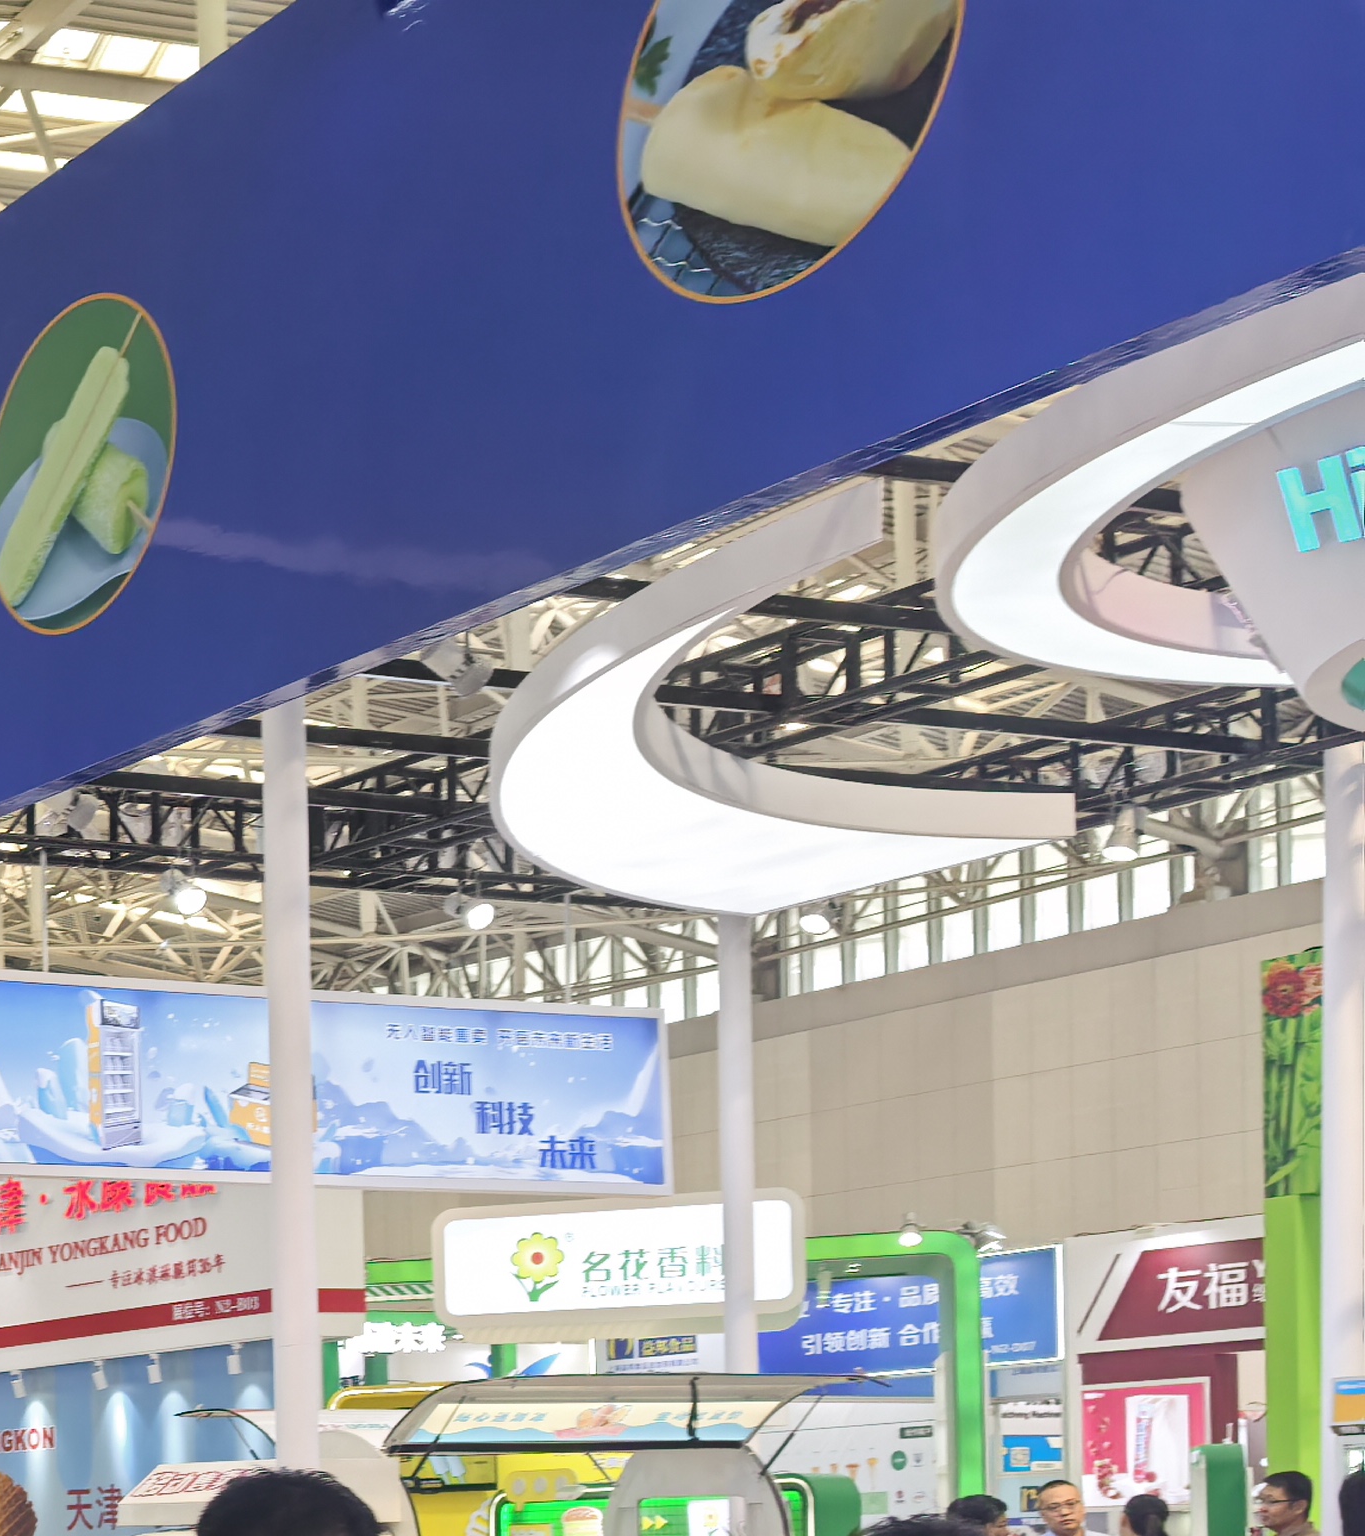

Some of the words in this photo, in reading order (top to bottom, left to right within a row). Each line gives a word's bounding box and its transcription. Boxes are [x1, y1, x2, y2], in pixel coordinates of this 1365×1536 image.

[413, 1060, 472, 1095] 创新
[475, 1101, 534, 1135] 科技
[538, 1135, 597, 1169] 未来
[49, 1228, 149, 1264] YONGKANG
[155, 1217, 207, 1245] FOOD
[1157, 1262, 1248, 1313] 友福
[802, 1327, 891, 1356] 引领创新
[66, 1484, 121, 1530] 天津
